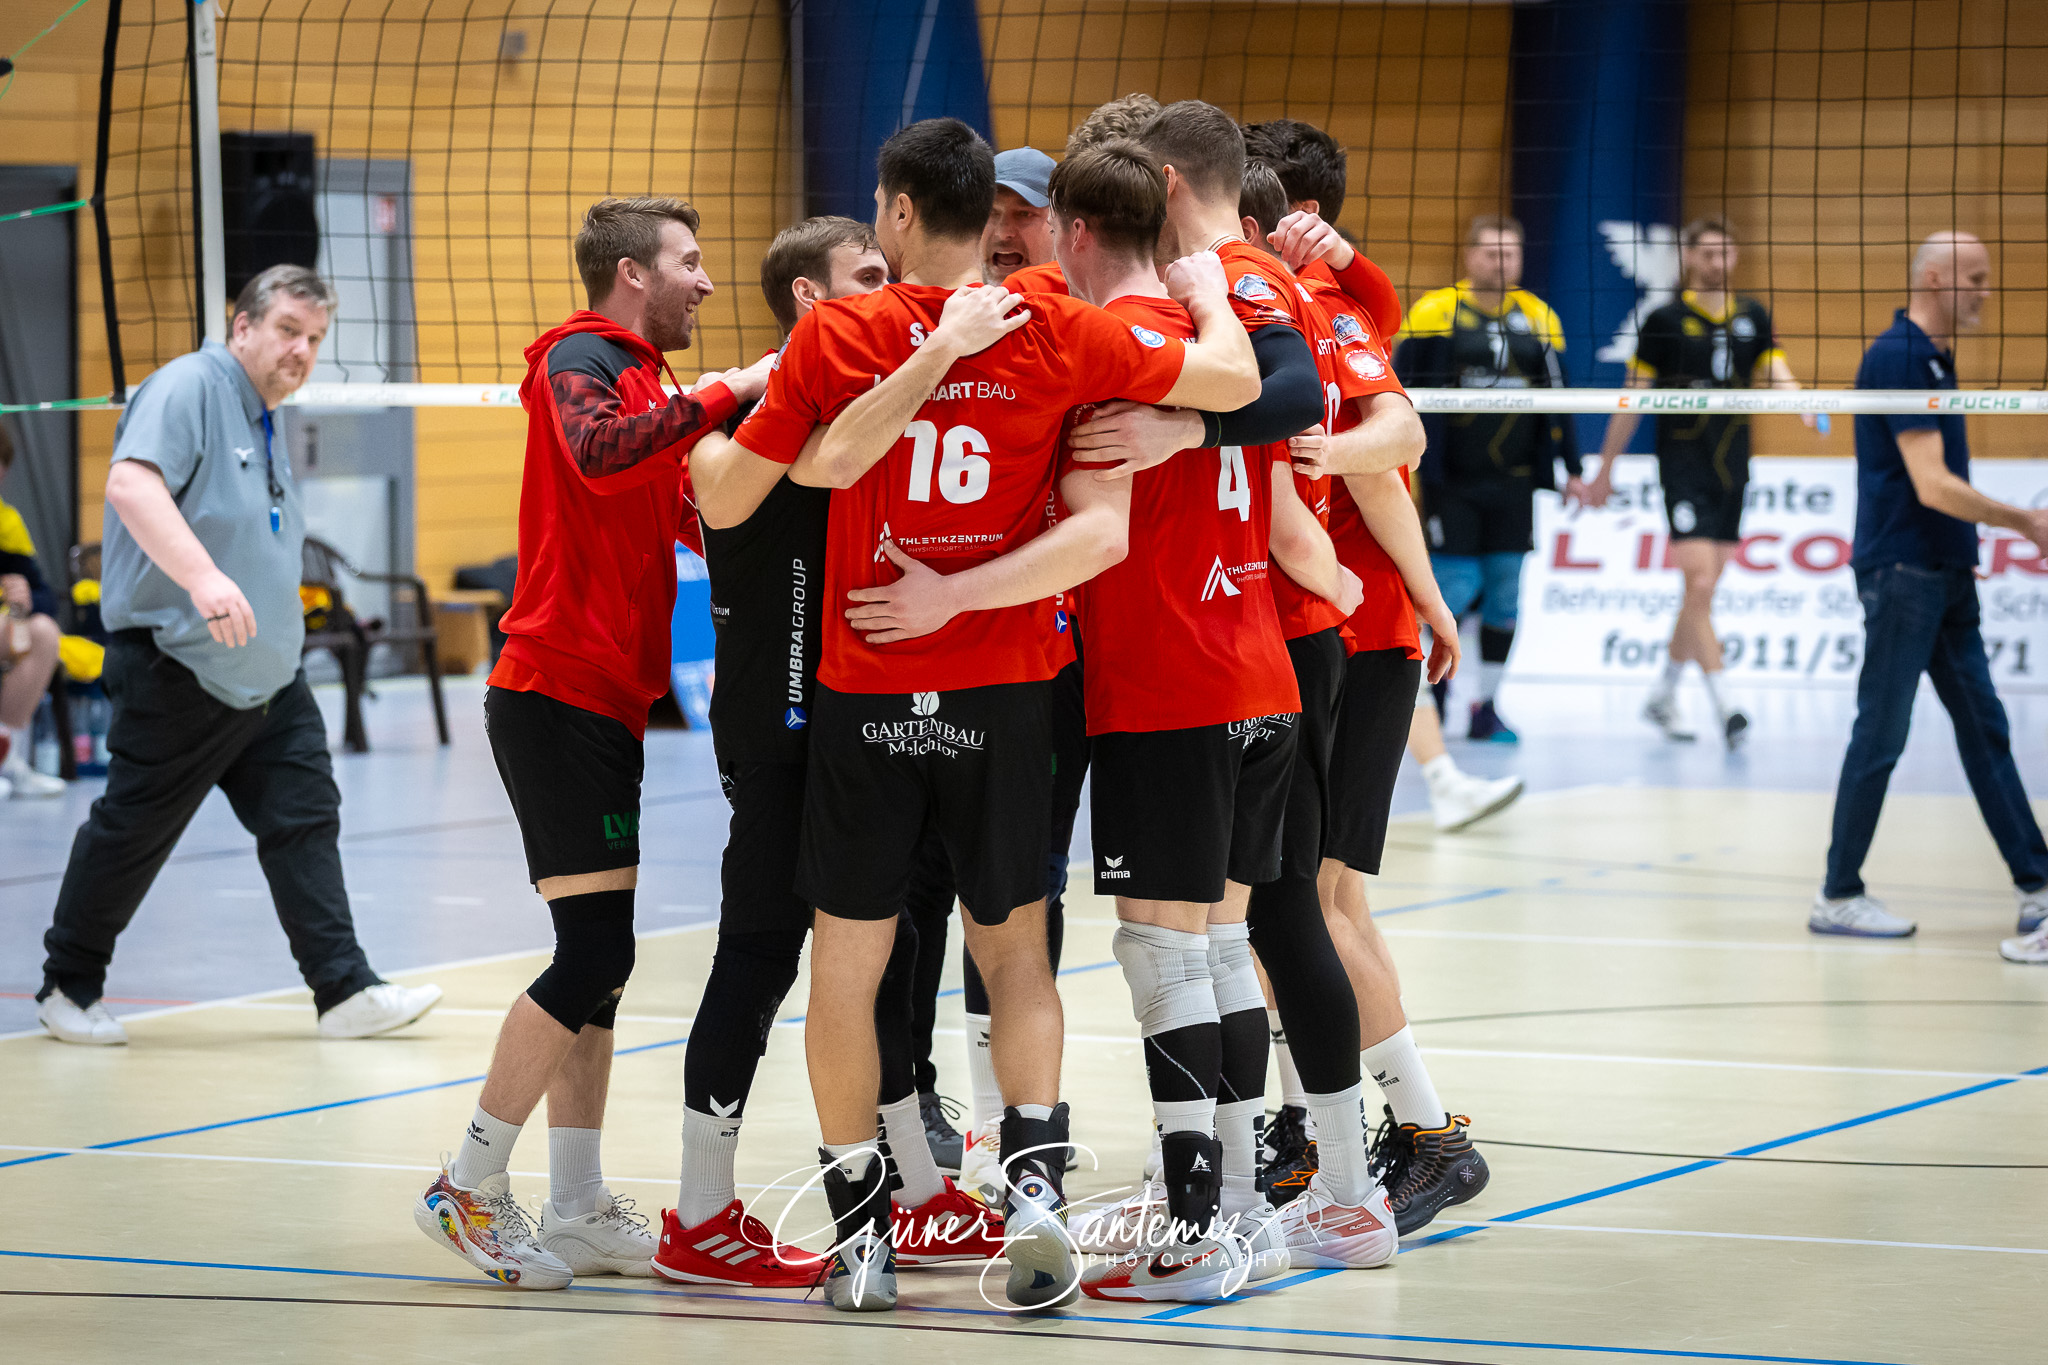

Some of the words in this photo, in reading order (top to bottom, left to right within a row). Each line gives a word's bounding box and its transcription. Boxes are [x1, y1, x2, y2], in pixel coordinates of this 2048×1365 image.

[977, 381, 1016, 400] BAU
[1638, 396, 1709, 409] FUCHS
[1949, 396, 2022, 409] FUCHS
[904, 420, 991, 504] 16
[1218, 446, 1250, 522] 4
[788, 559, 806, 703] UMBRAGROUP
[862, 717, 986, 746] GARTENBAU
[887, 737, 959, 760] Melchior
[1100, 869, 1131, 879] erima
[1378, 1076, 1400, 1088] rima
